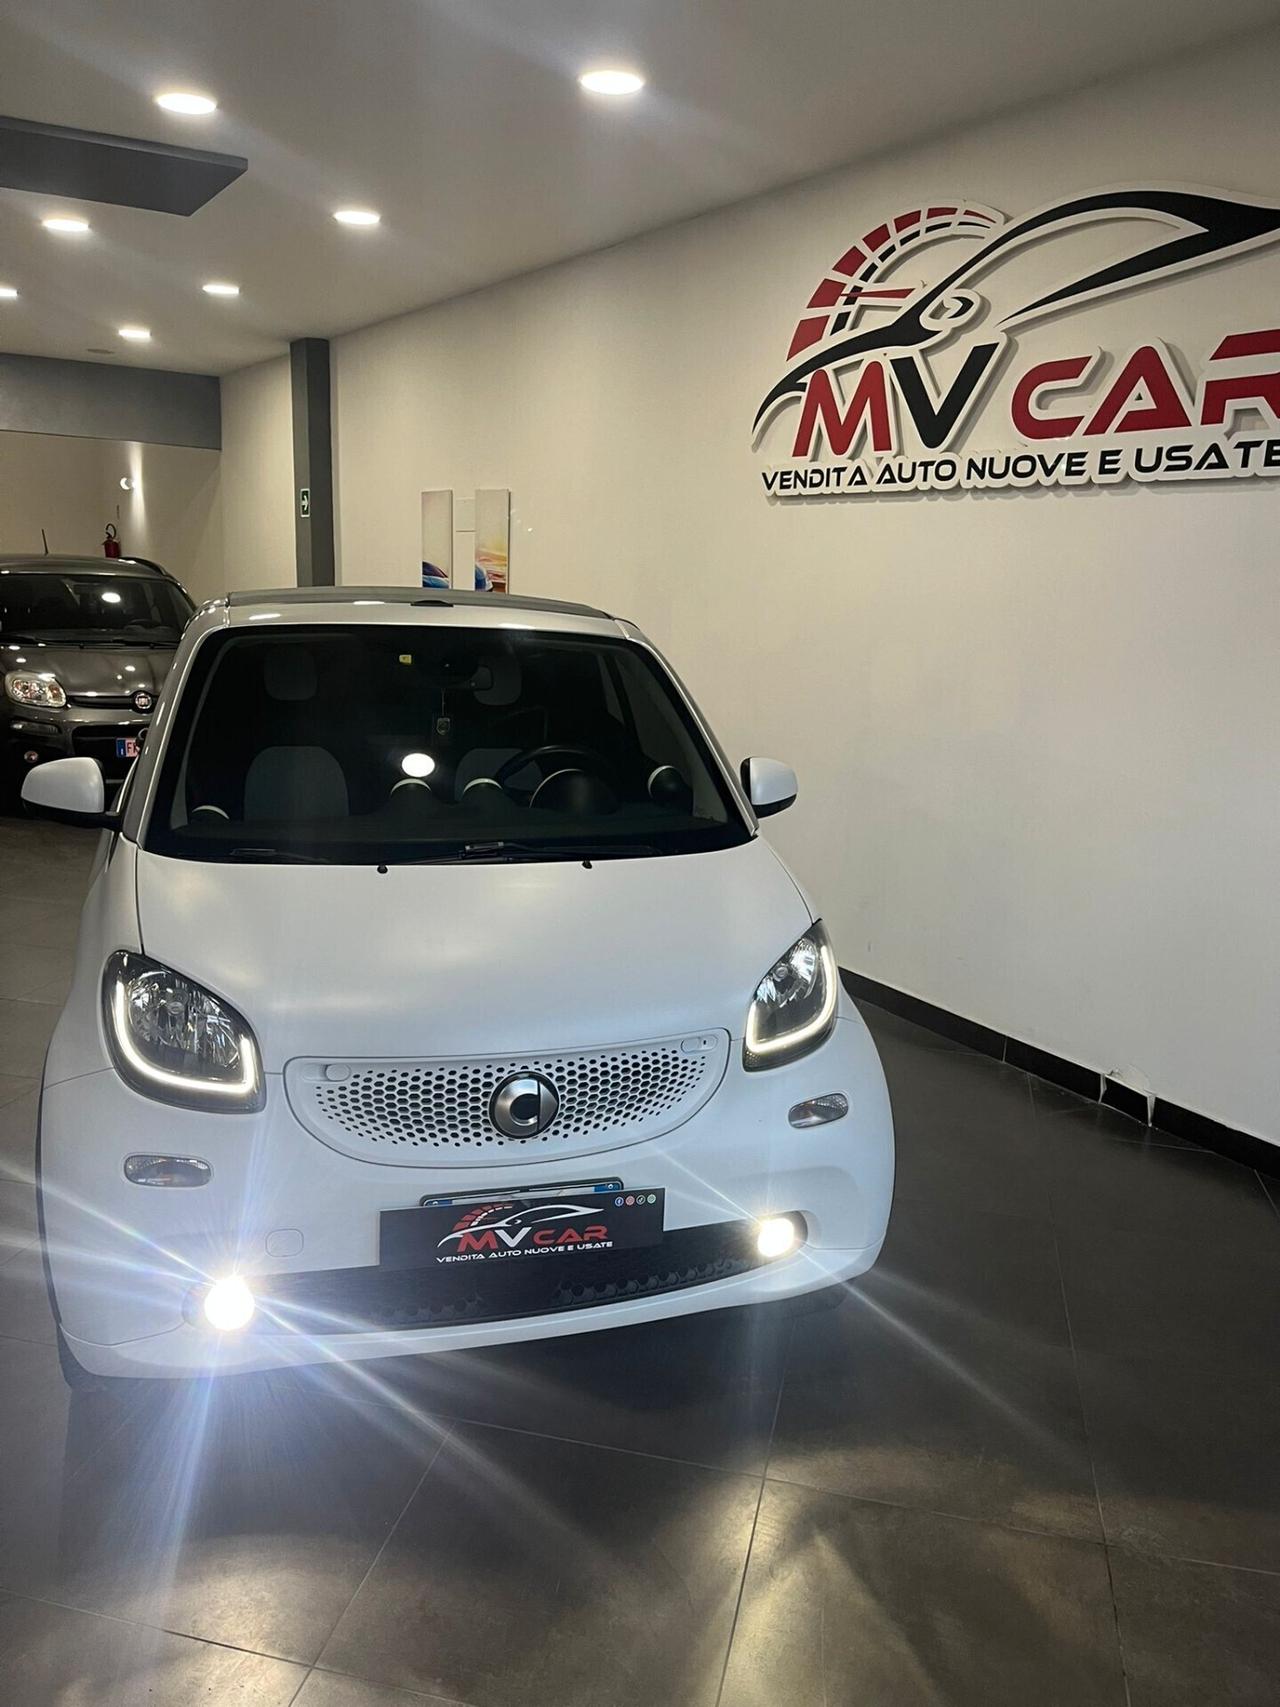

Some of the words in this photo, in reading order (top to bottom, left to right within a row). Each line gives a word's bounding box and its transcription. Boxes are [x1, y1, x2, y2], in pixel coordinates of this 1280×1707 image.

[792, 342, 1000, 458] MV
[1011, 328, 1280, 440] CAR
[761, 466, 868, 491] VENDITA
[876, 459, 957, 485] AUTO
[966, 451, 1088, 480] NUOVE
[1098, 449, 1122, 474] E
[436, 1253, 485, 1263] VENDITA
[488, 1249, 522, 1259] AUTO
[524, 1246, 566, 1256] NUOVE
[576, 1241, 614, 1250] USATE
[457, 1226, 532, 1253] MV
[533, 1225, 609, 1246] CAR
